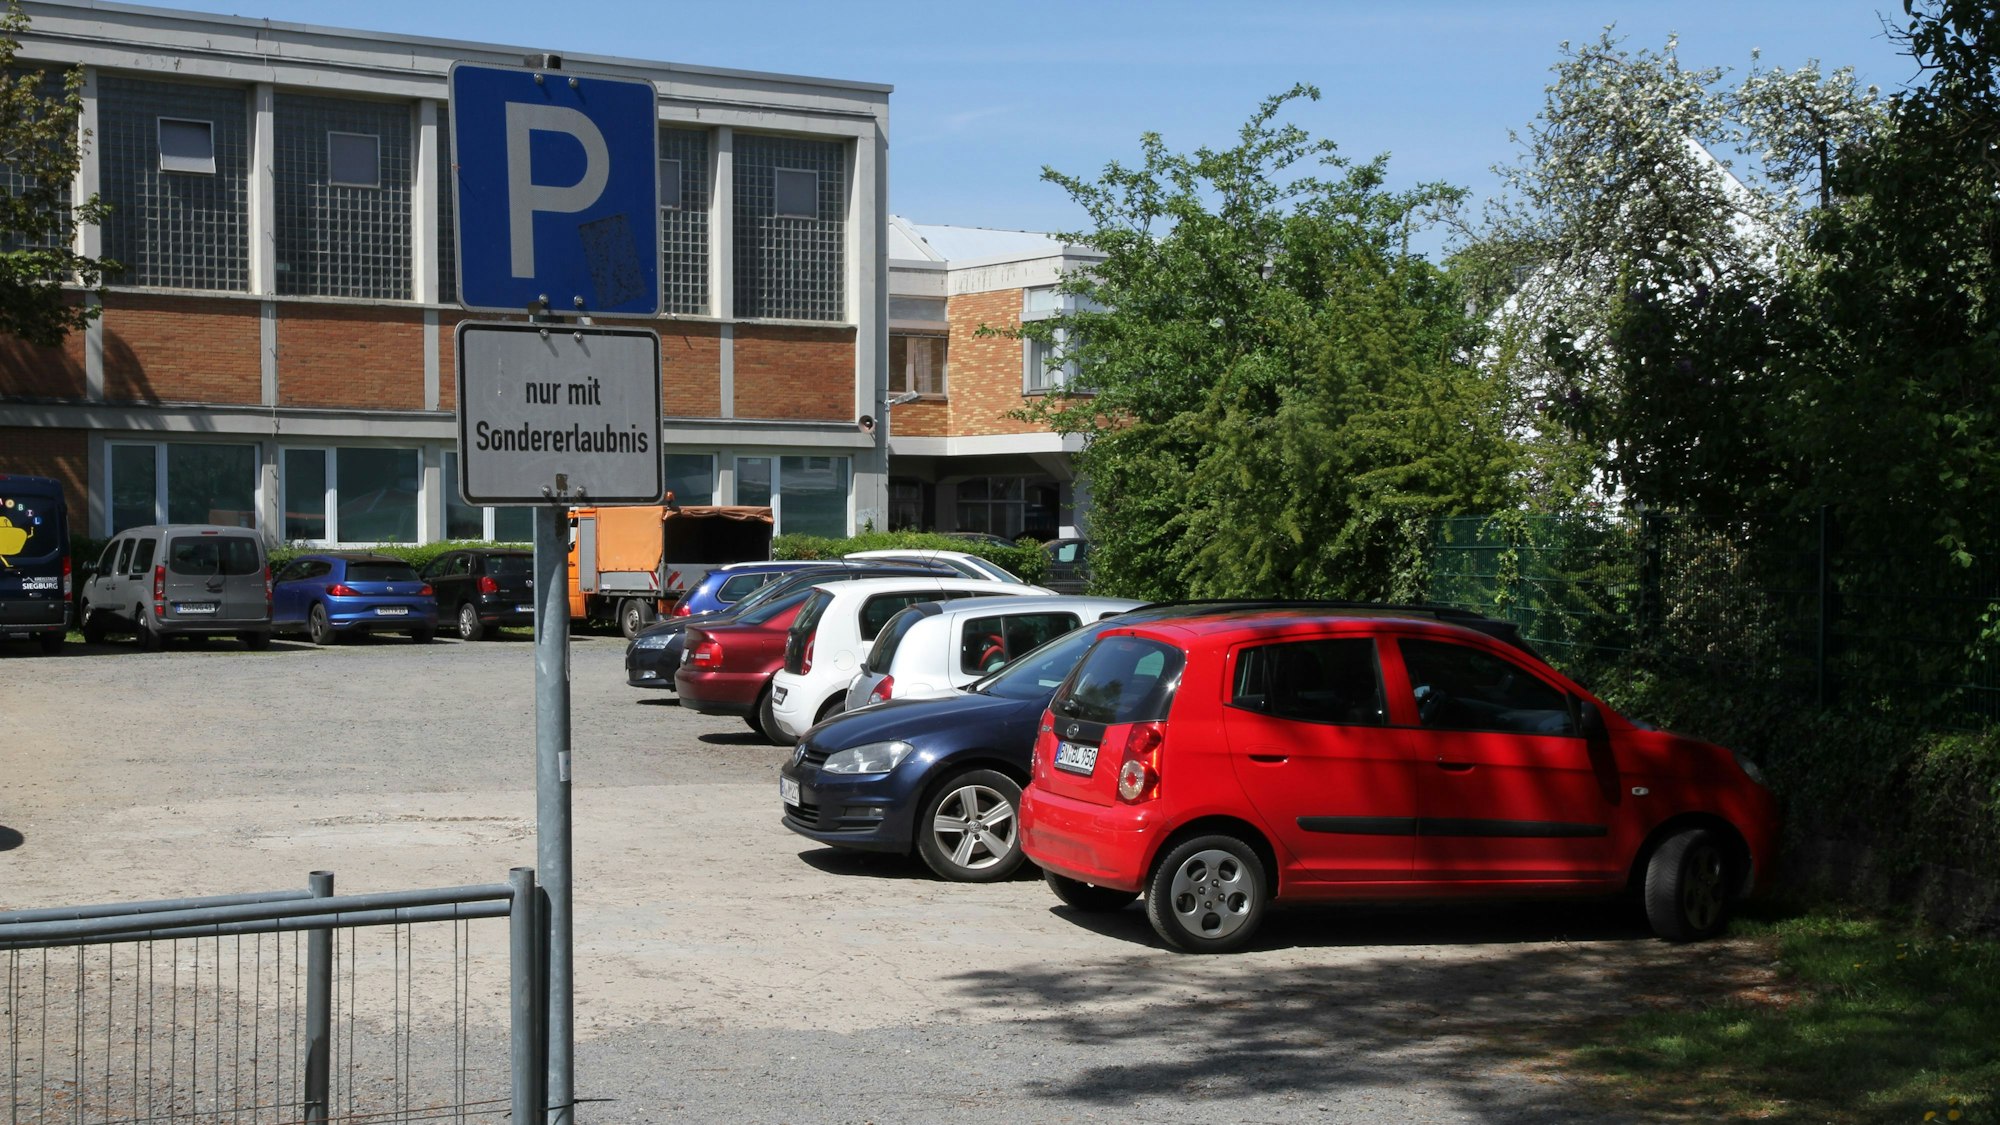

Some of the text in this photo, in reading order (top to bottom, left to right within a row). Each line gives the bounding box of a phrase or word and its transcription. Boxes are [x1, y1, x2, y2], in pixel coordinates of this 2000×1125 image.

[505, 101, 610, 279] P
[525, 376, 601, 405] nur mit
[476, 420, 648, 453] Sondererlaubnis
[22, 582, 58, 590] SIEGBURG
[1080, 748, 1097, 767] 958
